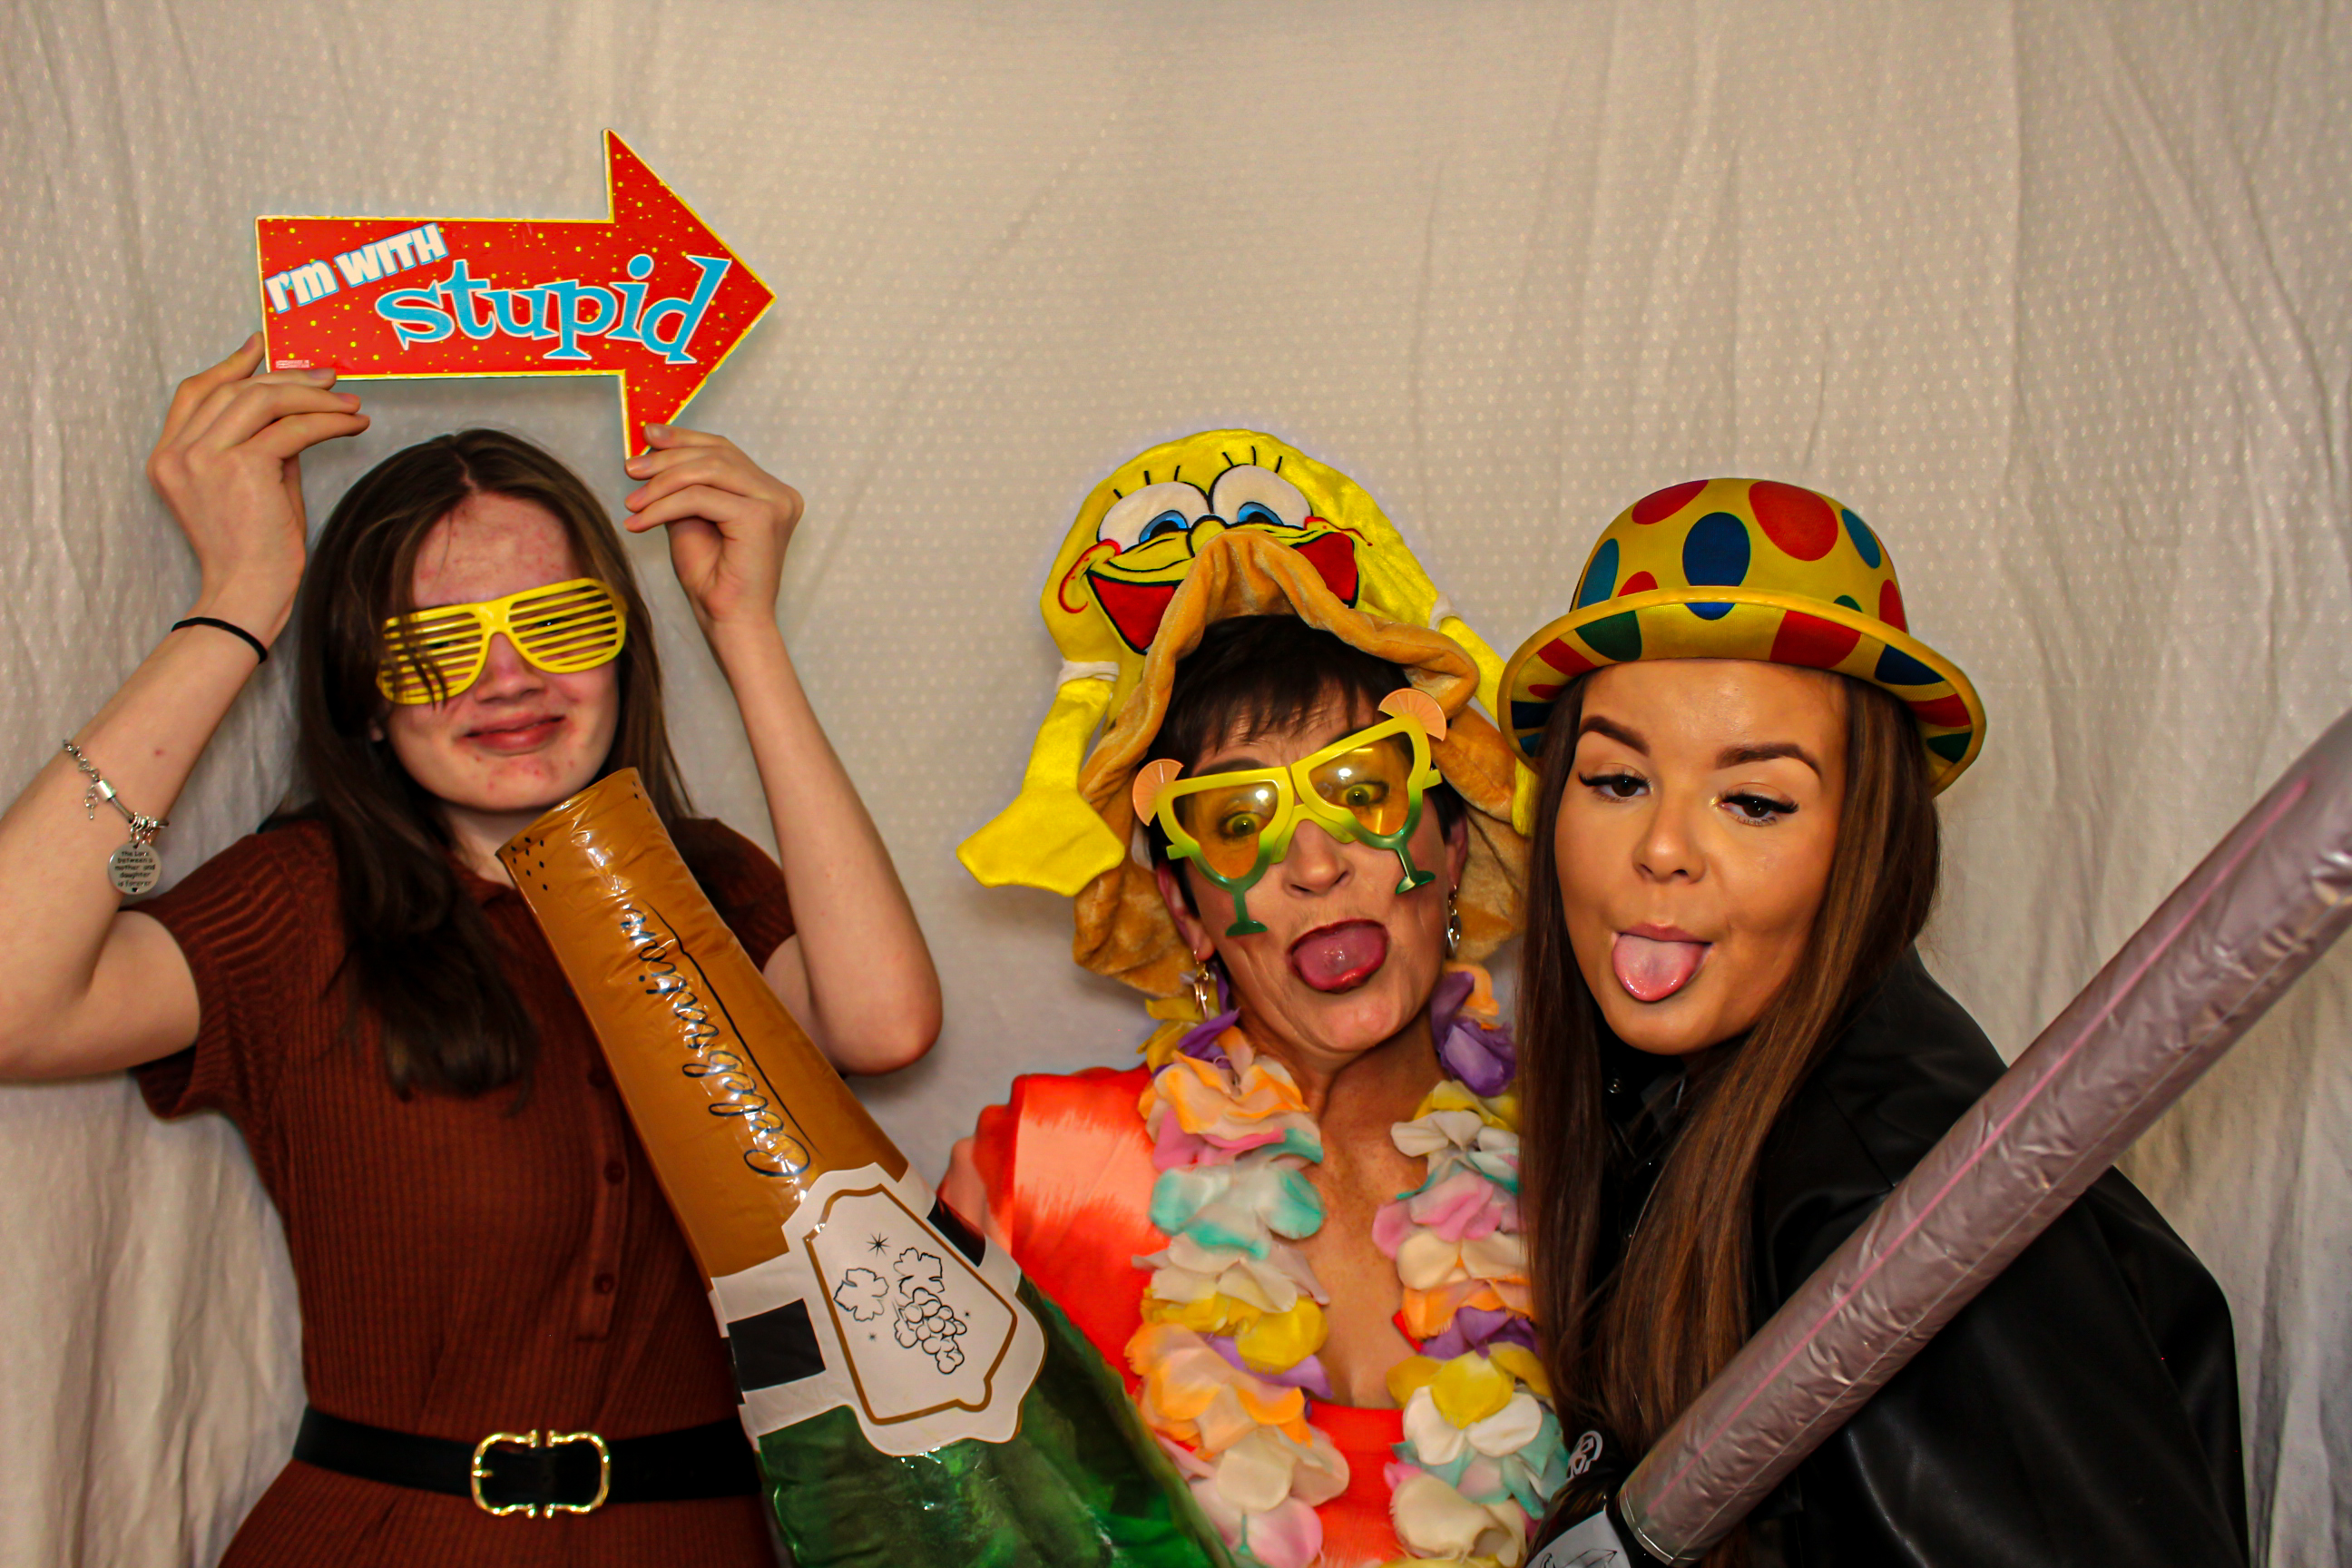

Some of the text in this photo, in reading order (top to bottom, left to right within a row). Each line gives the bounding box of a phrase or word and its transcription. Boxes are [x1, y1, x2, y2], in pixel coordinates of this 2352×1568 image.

[334, 222, 449, 288] WITH
[374, 253, 732, 364] stupid
[119, 871, 152, 879] daughter
[619, 904, 811, 1178] Celebration
